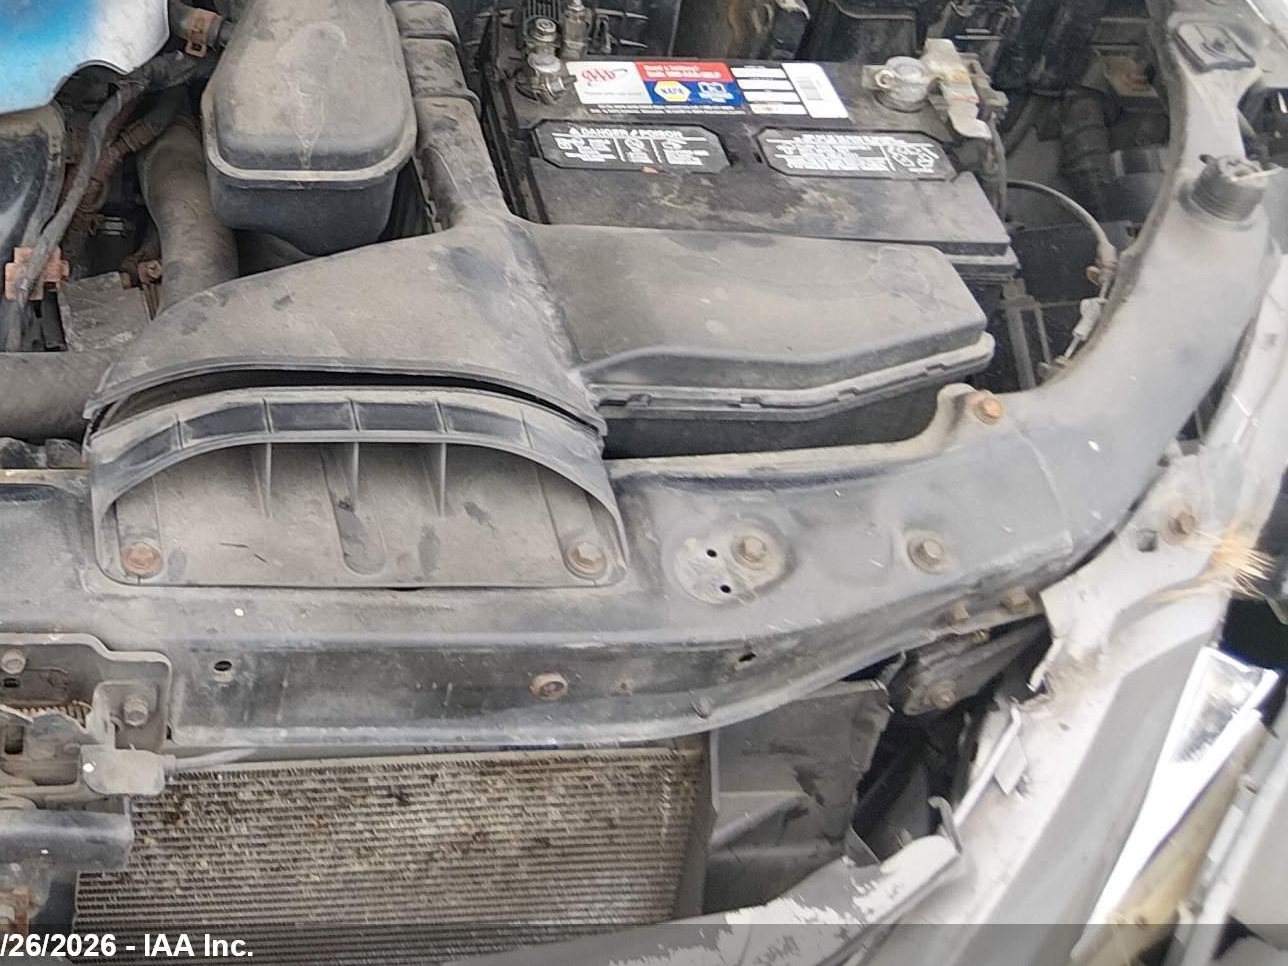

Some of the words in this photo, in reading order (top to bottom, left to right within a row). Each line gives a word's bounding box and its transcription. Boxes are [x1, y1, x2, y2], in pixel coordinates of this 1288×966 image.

[660, 87, 685, 96] NAPA
[580, 128, 629, 139] DANGER
[638, 129, 683, 139] POISON
